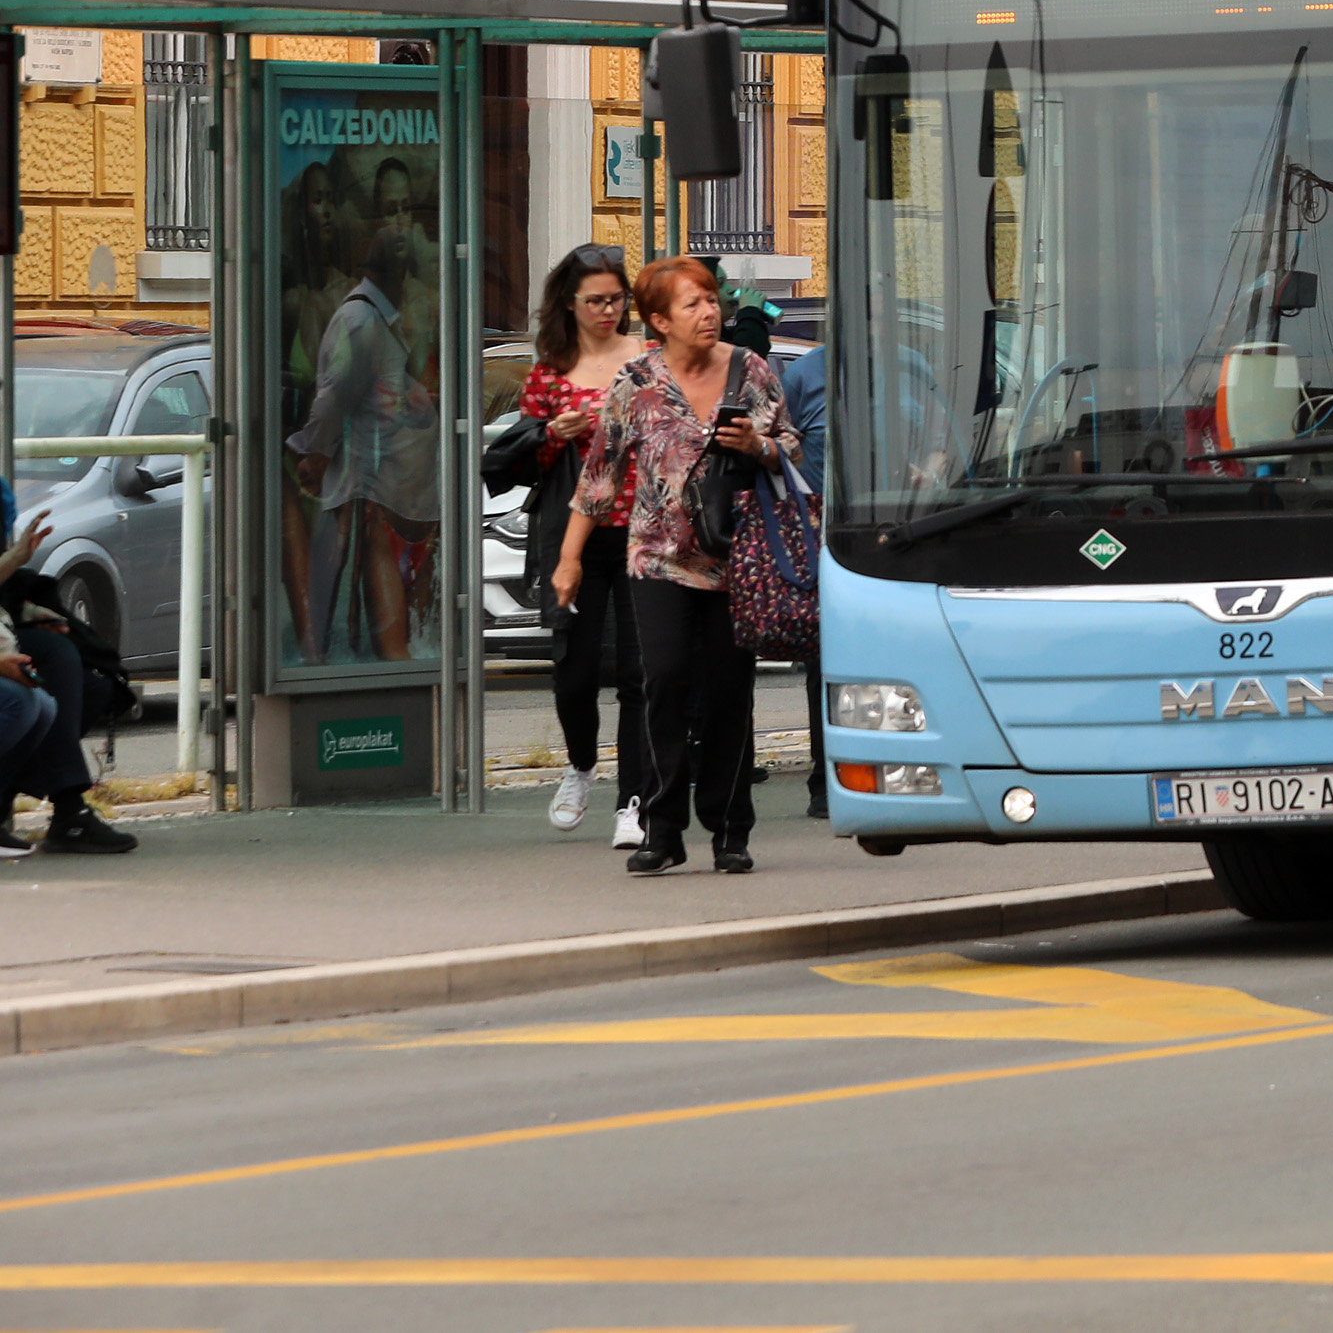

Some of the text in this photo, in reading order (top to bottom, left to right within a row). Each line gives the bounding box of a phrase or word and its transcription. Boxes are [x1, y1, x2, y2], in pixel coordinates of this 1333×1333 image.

[280, 108, 440, 145] CALZEDONIA
[1088, 542, 1116, 556] CNG
[1219, 631, 1274, 659] 822
[338, 729, 393, 751] europlakat
[1176, 781, 1208, 814] RI
